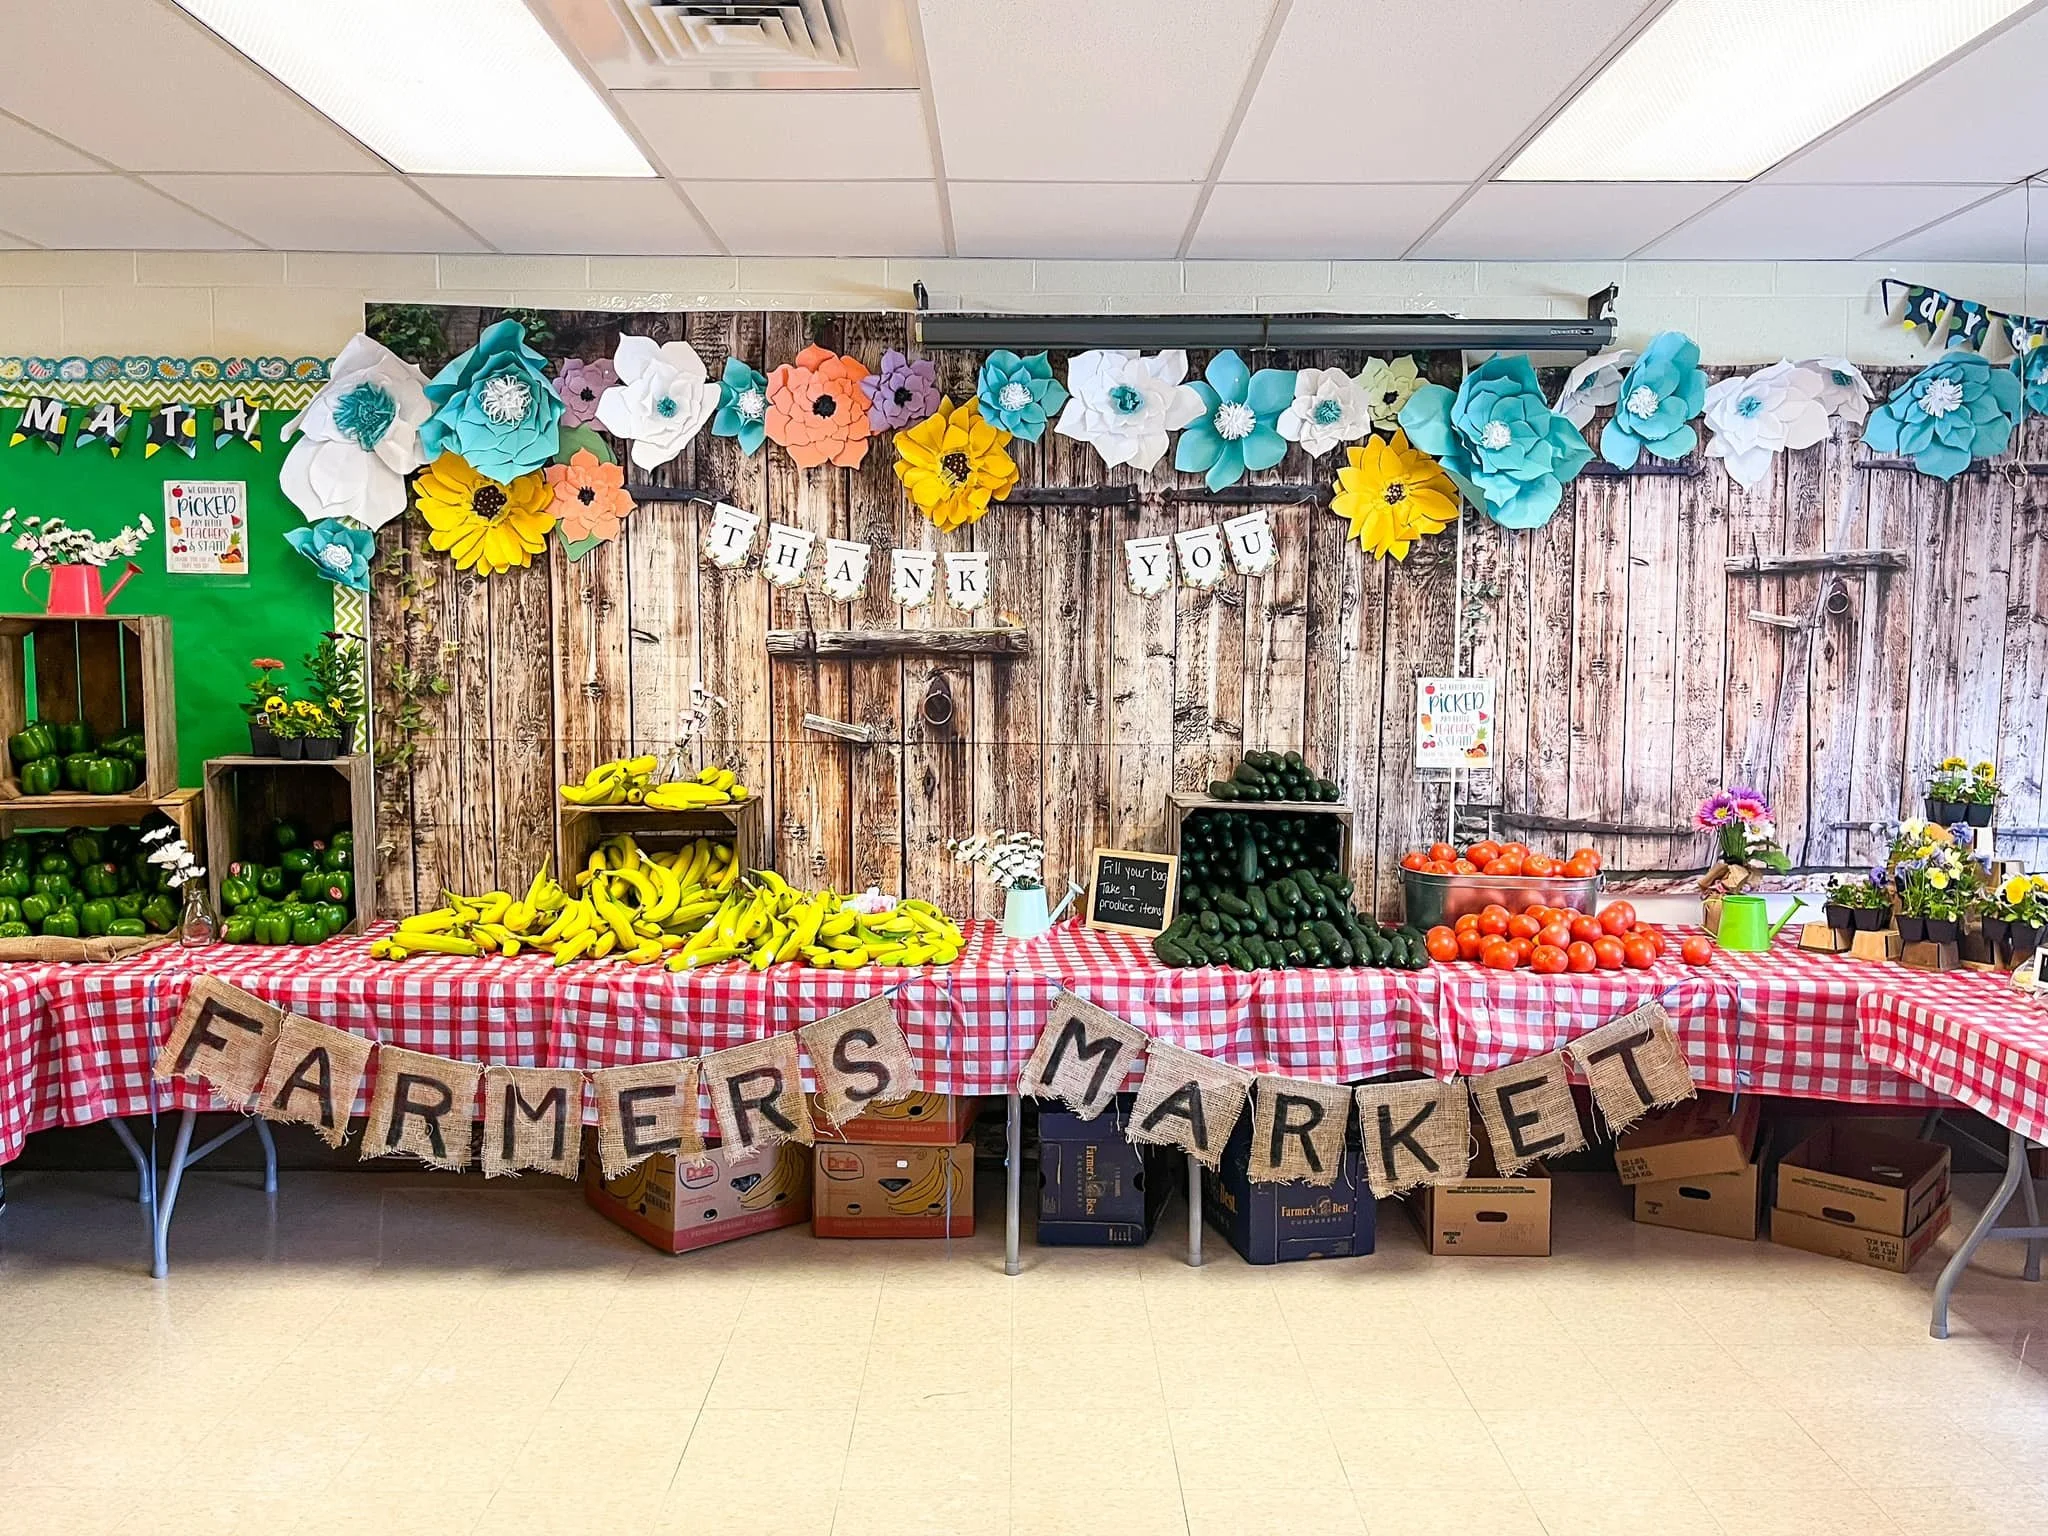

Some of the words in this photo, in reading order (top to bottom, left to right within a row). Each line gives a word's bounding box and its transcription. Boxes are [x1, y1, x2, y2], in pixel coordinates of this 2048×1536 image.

[24, 398, 248, 437] MATH
[185, 527, 229, 540] TEACHERS
[722, 523, 976, 592] THANK
[1138, 530, 1262, 577] YOU
[1103, 860, 1120, 875] Fill
[1125, 866, 1149, 880] your
[1099, 881, 1121, 894] Take
[1099, 899, 1136, 912] produce
[174, 995, 891, 1161] FARMERS
[1040, 1015, 1656, 1181] MARKET
[827, 1157, 858, 1169] Dole
[1085, 1145, 1098, 1181] Farmer's
[686, 1165, 714, 1179] Dole
[1085, 1198, 1097, 1215] Best
[1281, 1204, 1316, 1217] Farmer's
[1332, 1203, 1349, 1213] Best
